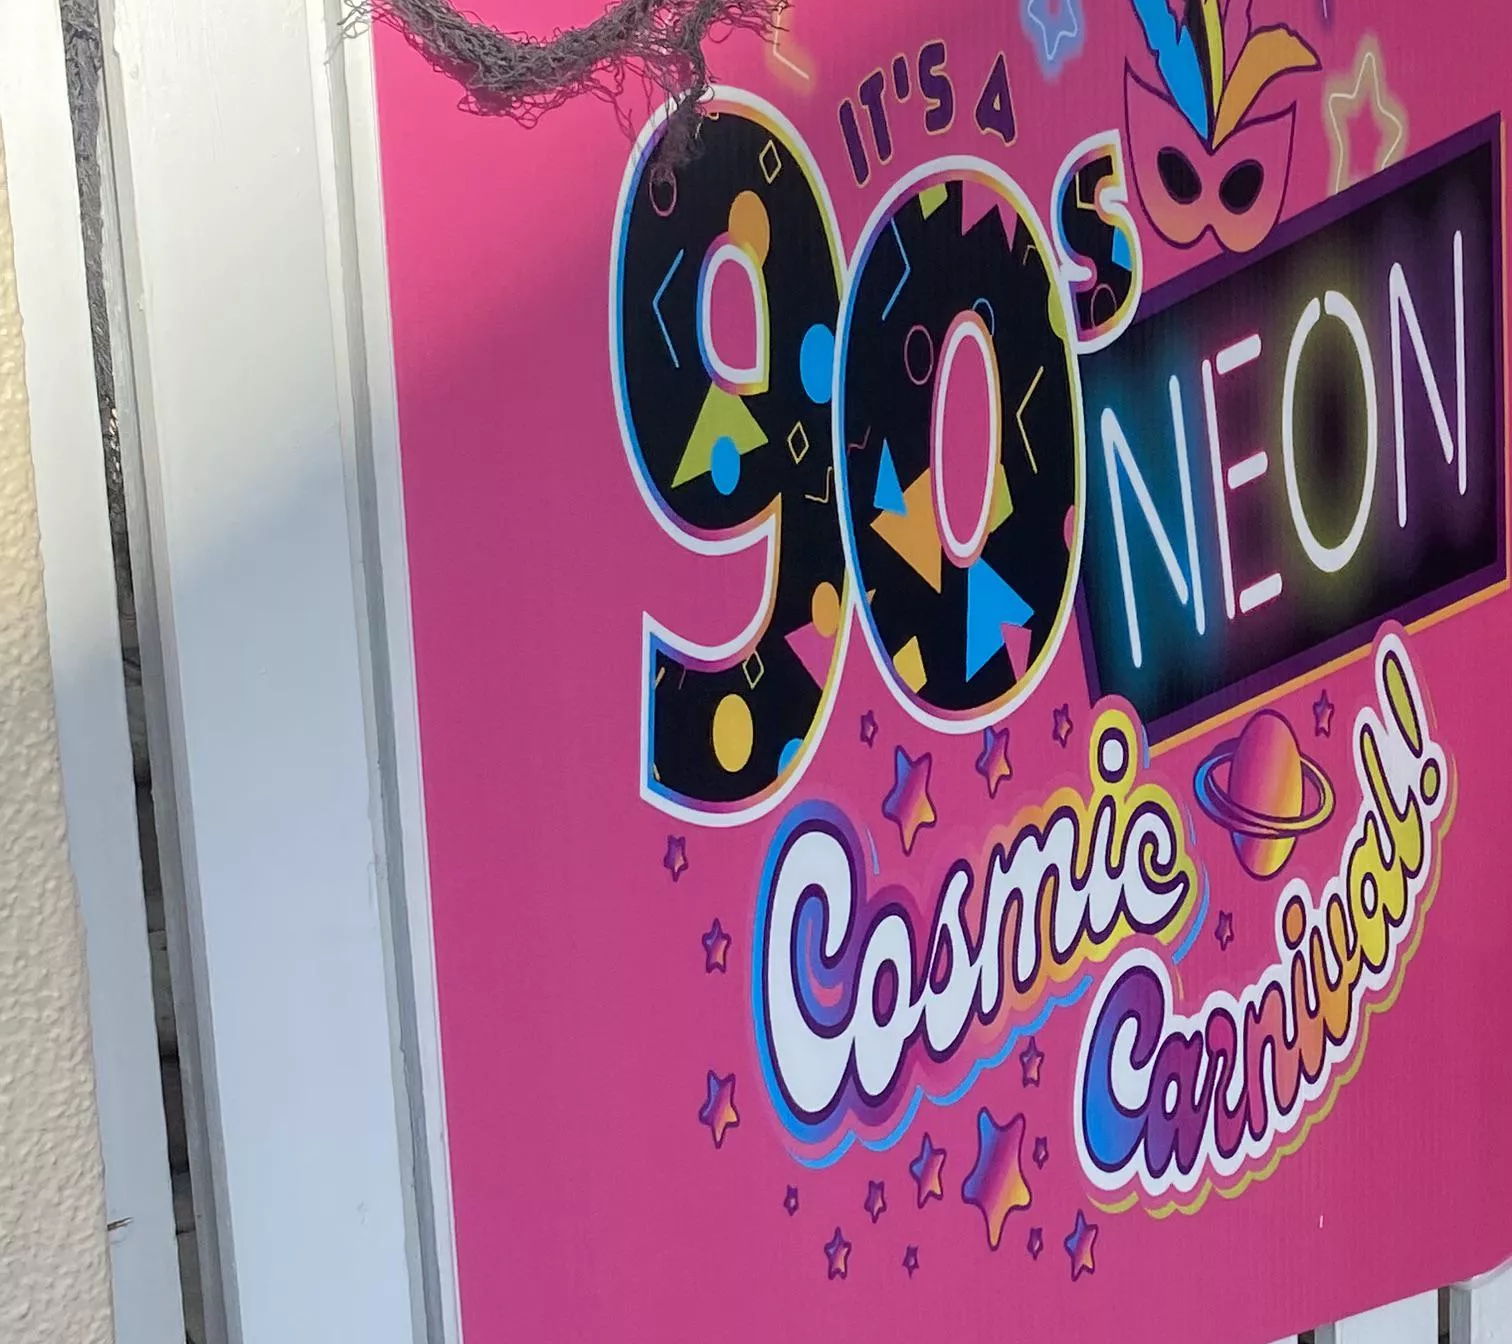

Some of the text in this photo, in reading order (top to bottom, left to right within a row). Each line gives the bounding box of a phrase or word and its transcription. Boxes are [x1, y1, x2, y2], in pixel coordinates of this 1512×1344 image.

[838, 39, 1017, 188] IT'S A
[1101, 230, 1468, 668] NEON
[762, 724, 1190, 1128] Cosmic
[1078, 631, 1447, 1197] Carnival!
